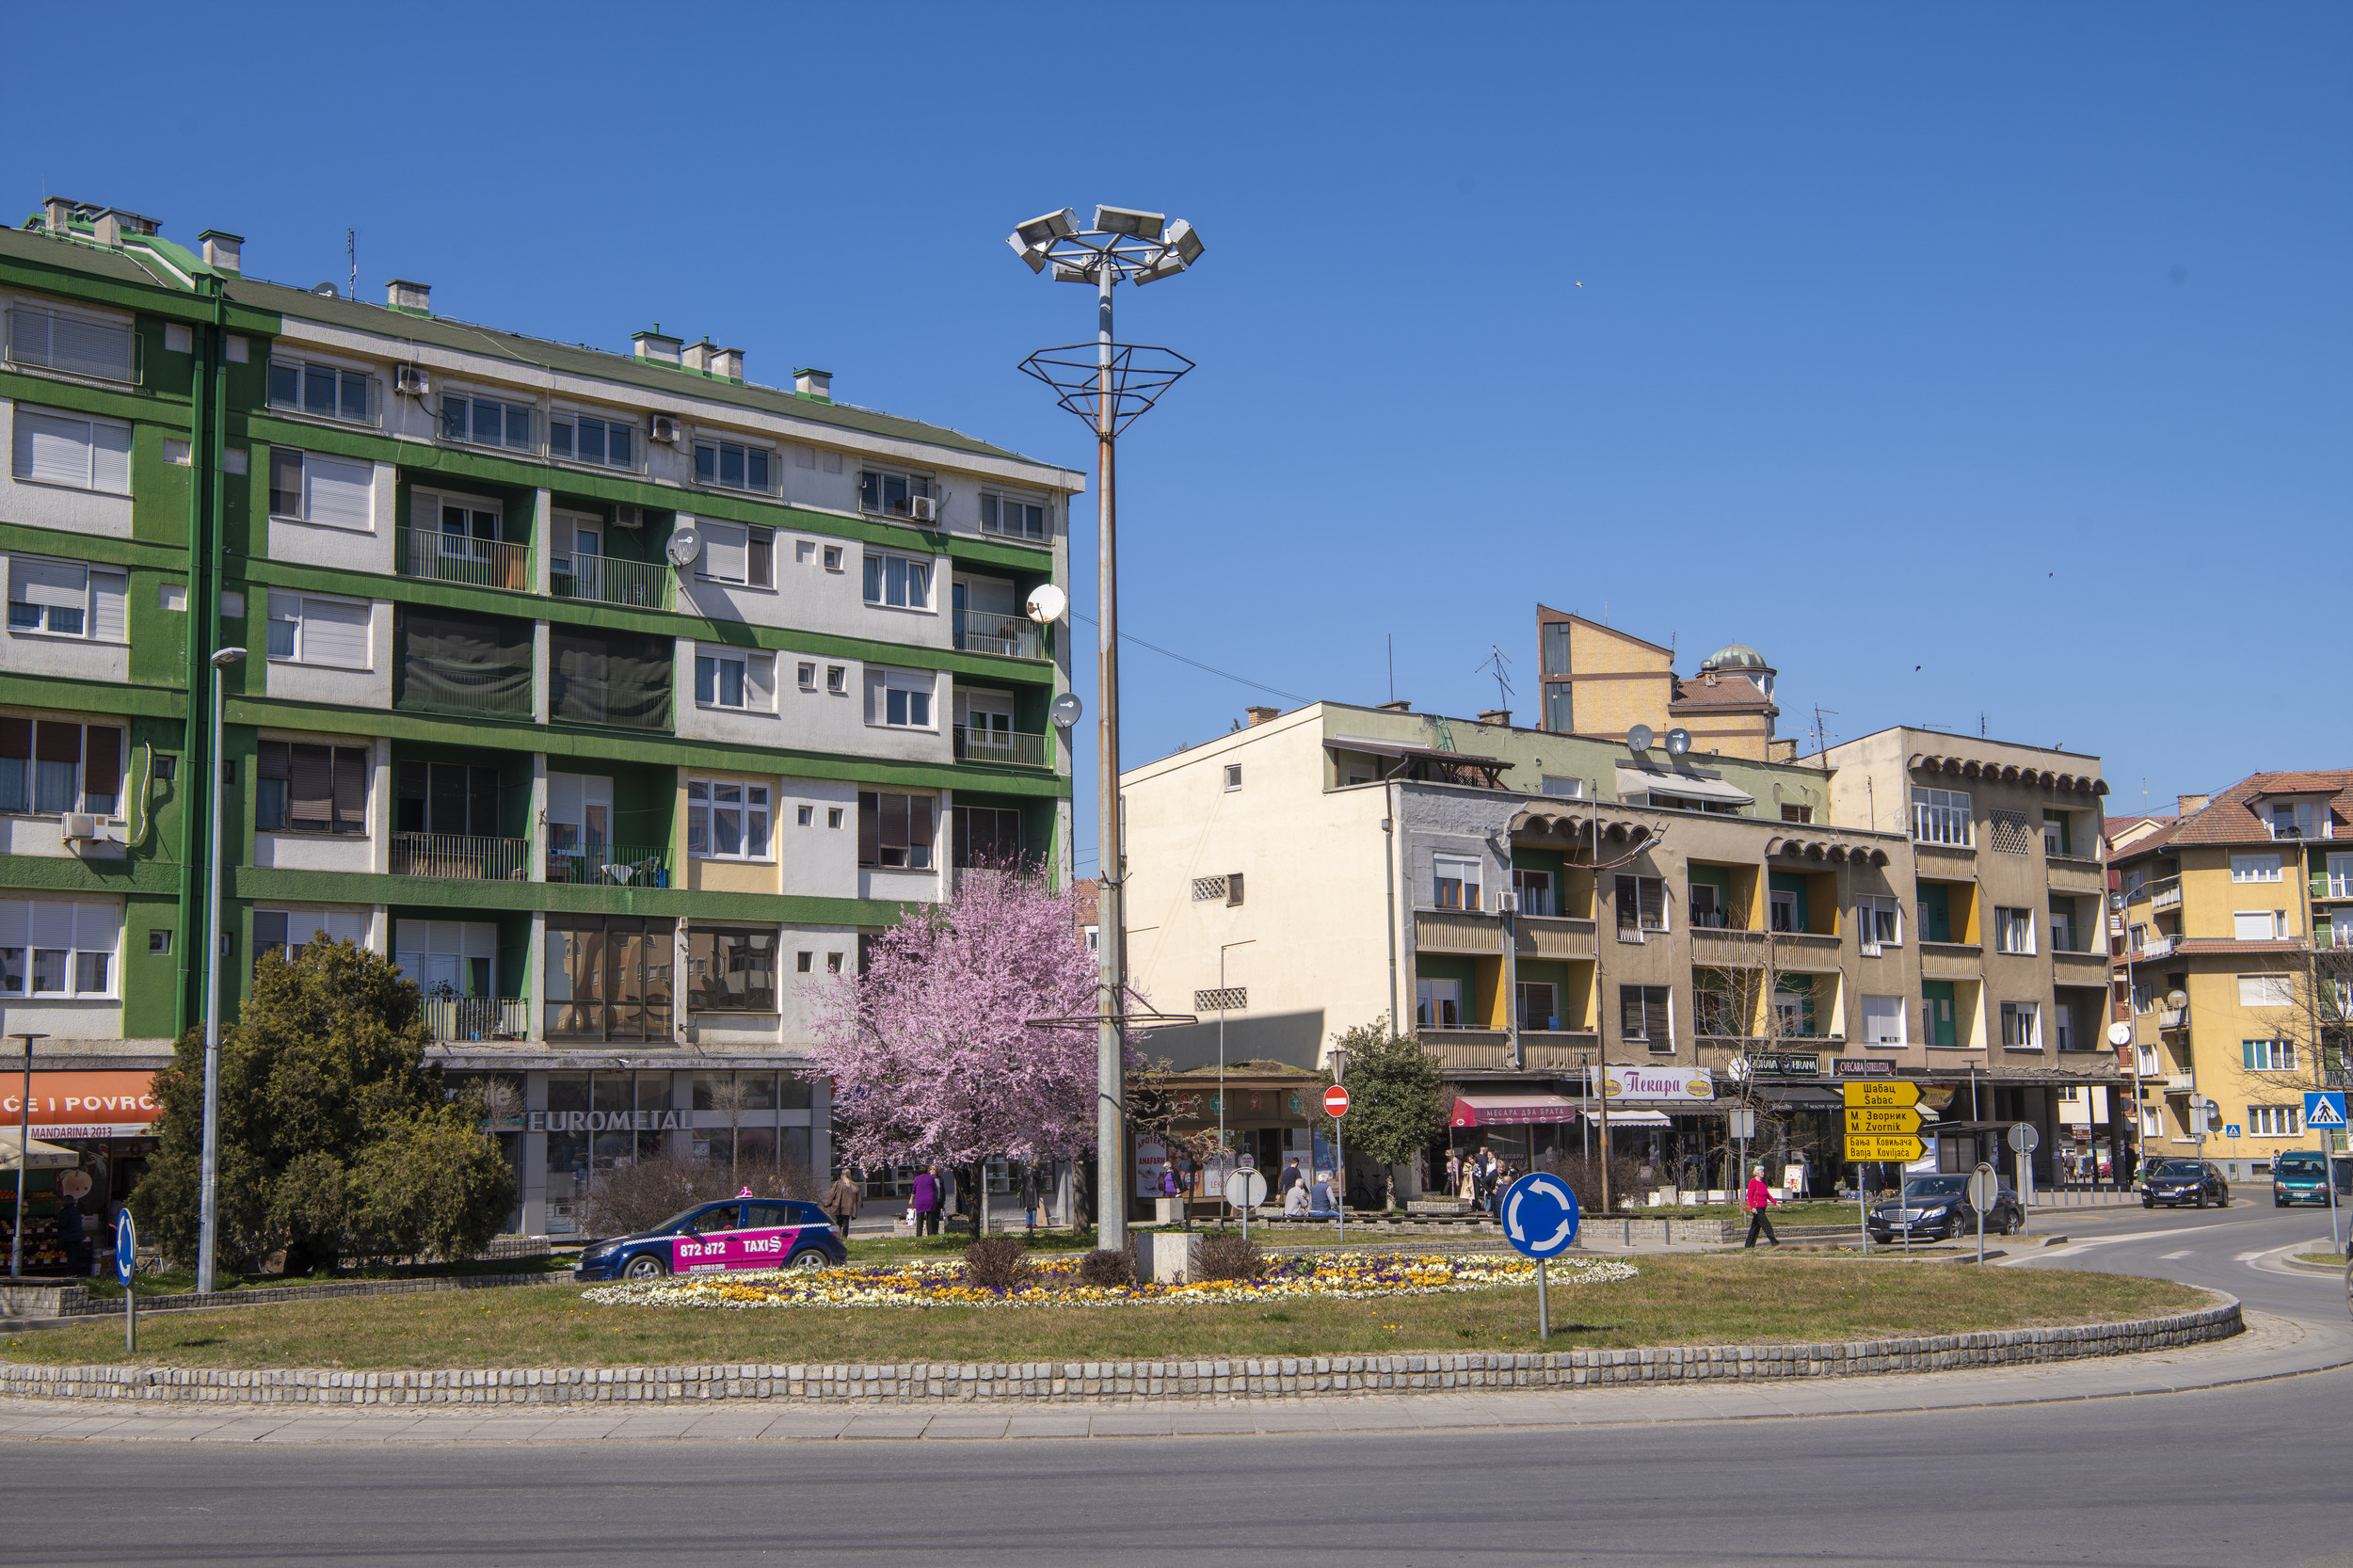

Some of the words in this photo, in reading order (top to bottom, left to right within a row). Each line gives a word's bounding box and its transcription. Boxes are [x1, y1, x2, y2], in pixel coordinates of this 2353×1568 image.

[1792, 1060, 1817, 1070] HRANA
[1840, 1060, 1865, 1072] CVEĆARA
[1624, 1071, 1681, 1096] Пекара
[1863, 1083, 1896, 1094] Шабац
[1, 1096, 39, 1112] ĆE
[49, 1097, 56, 1112] I
[1865, 1094, 1894, 1104] Šabac
[527, 1110, 693, 1132] EUROMETAL
[1850, 1111, 1862, 1120] М.
[1866, 1111, 1907, 1122] Зворник
[1851, 1122, 1863, 1131] M.
[1865, 1122, 1901, 1131] Zvornik
[31, 1127, 88, 1139] MANDARINA
[90, 1127, 112, 1137] 2013
[1137, 1135, 1165, 1149] APOTEKA
[1849, 1137, 1870, 1146] Бања
[1876, 1137, 1913, 1146] Ковиљача
[1850, 1147, 1871, 1159] Banja
[1877, 1147, 1910, 1159] Koviljača
[1138, 1157, 1165, 1165] ANAFARM
[680, 1243, 702, 1257] 872
[704, 1241, 726, 1256] 872
